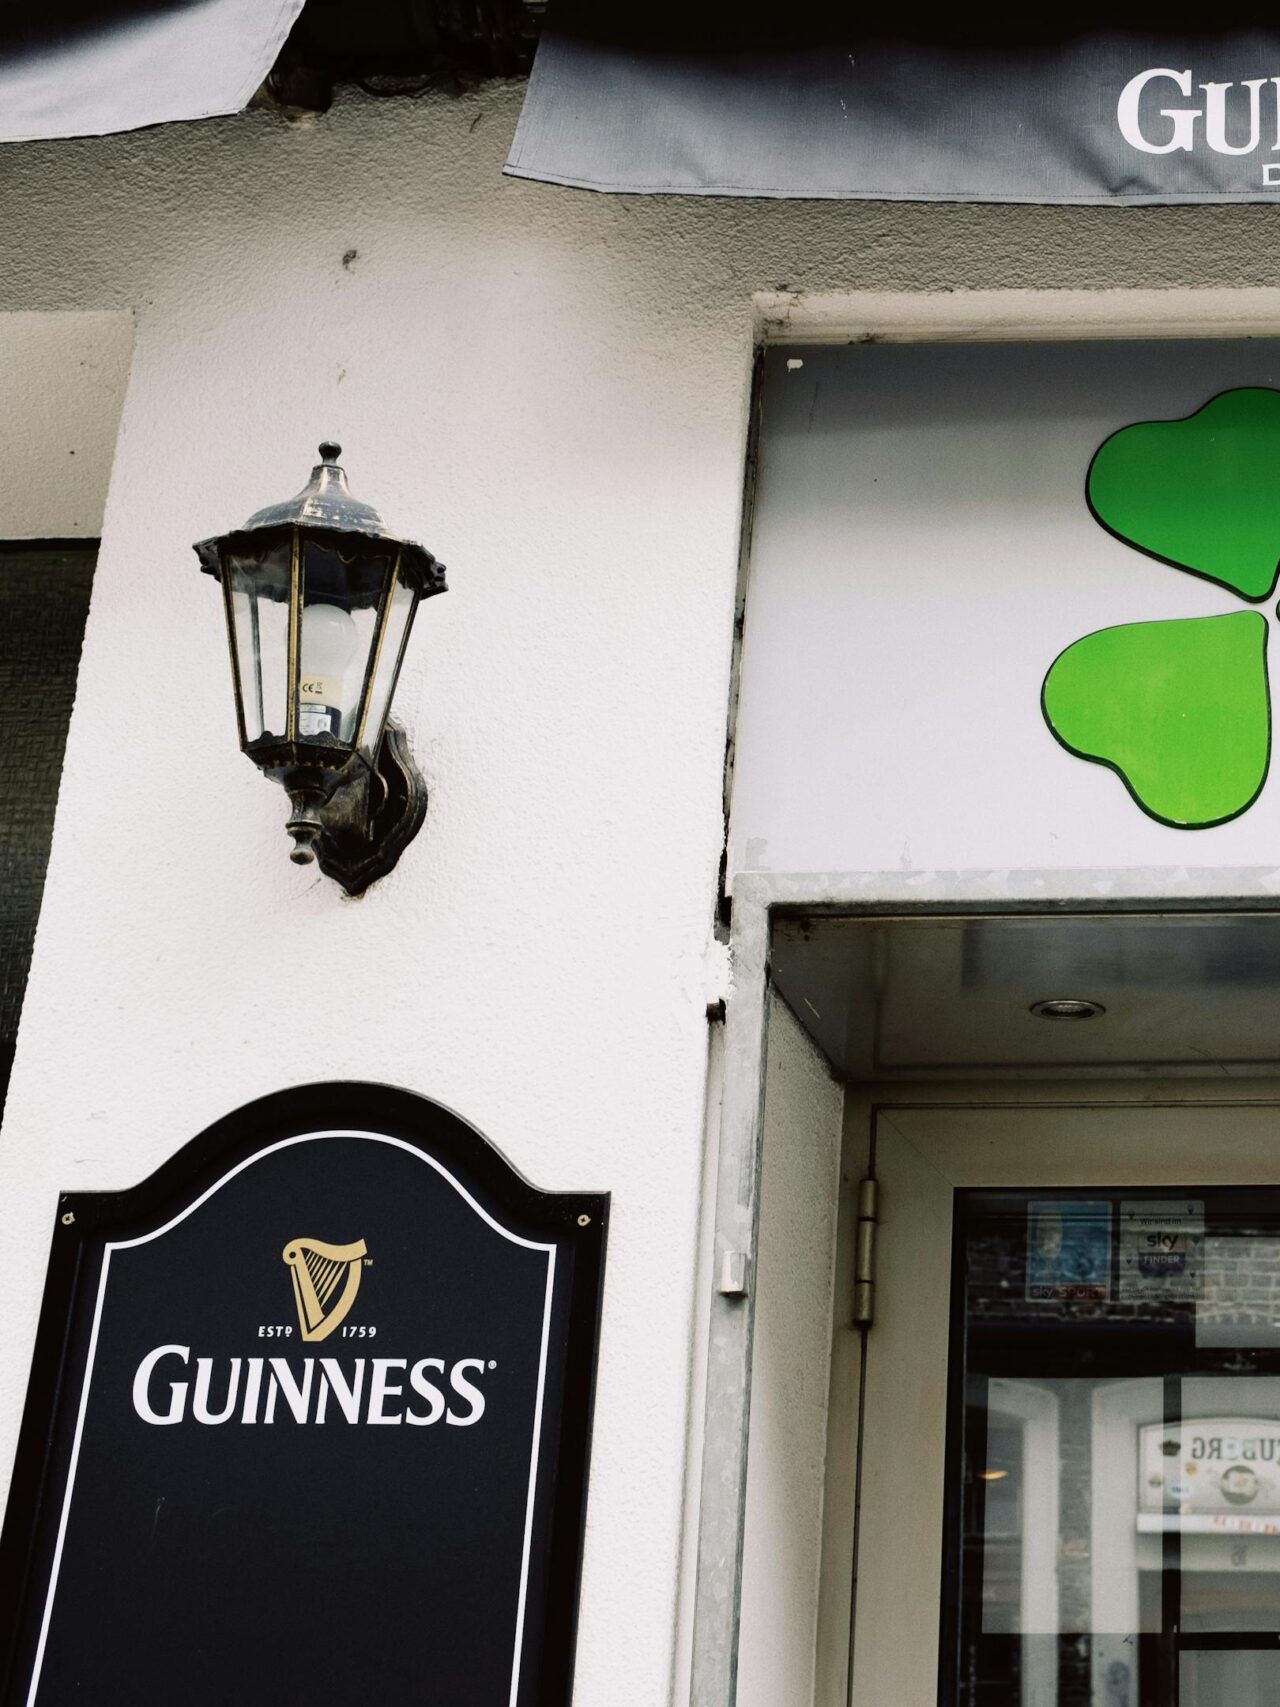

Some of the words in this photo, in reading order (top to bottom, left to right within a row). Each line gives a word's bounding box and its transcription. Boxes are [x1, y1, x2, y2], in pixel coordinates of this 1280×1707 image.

[1147, 1231, 1179, 1251] sky
[1144, 1255, 1180, 1264] FINDER
[342, 1325, 378, 1338] 1759
[132, 1344, 486, 1427] GUINNESS
